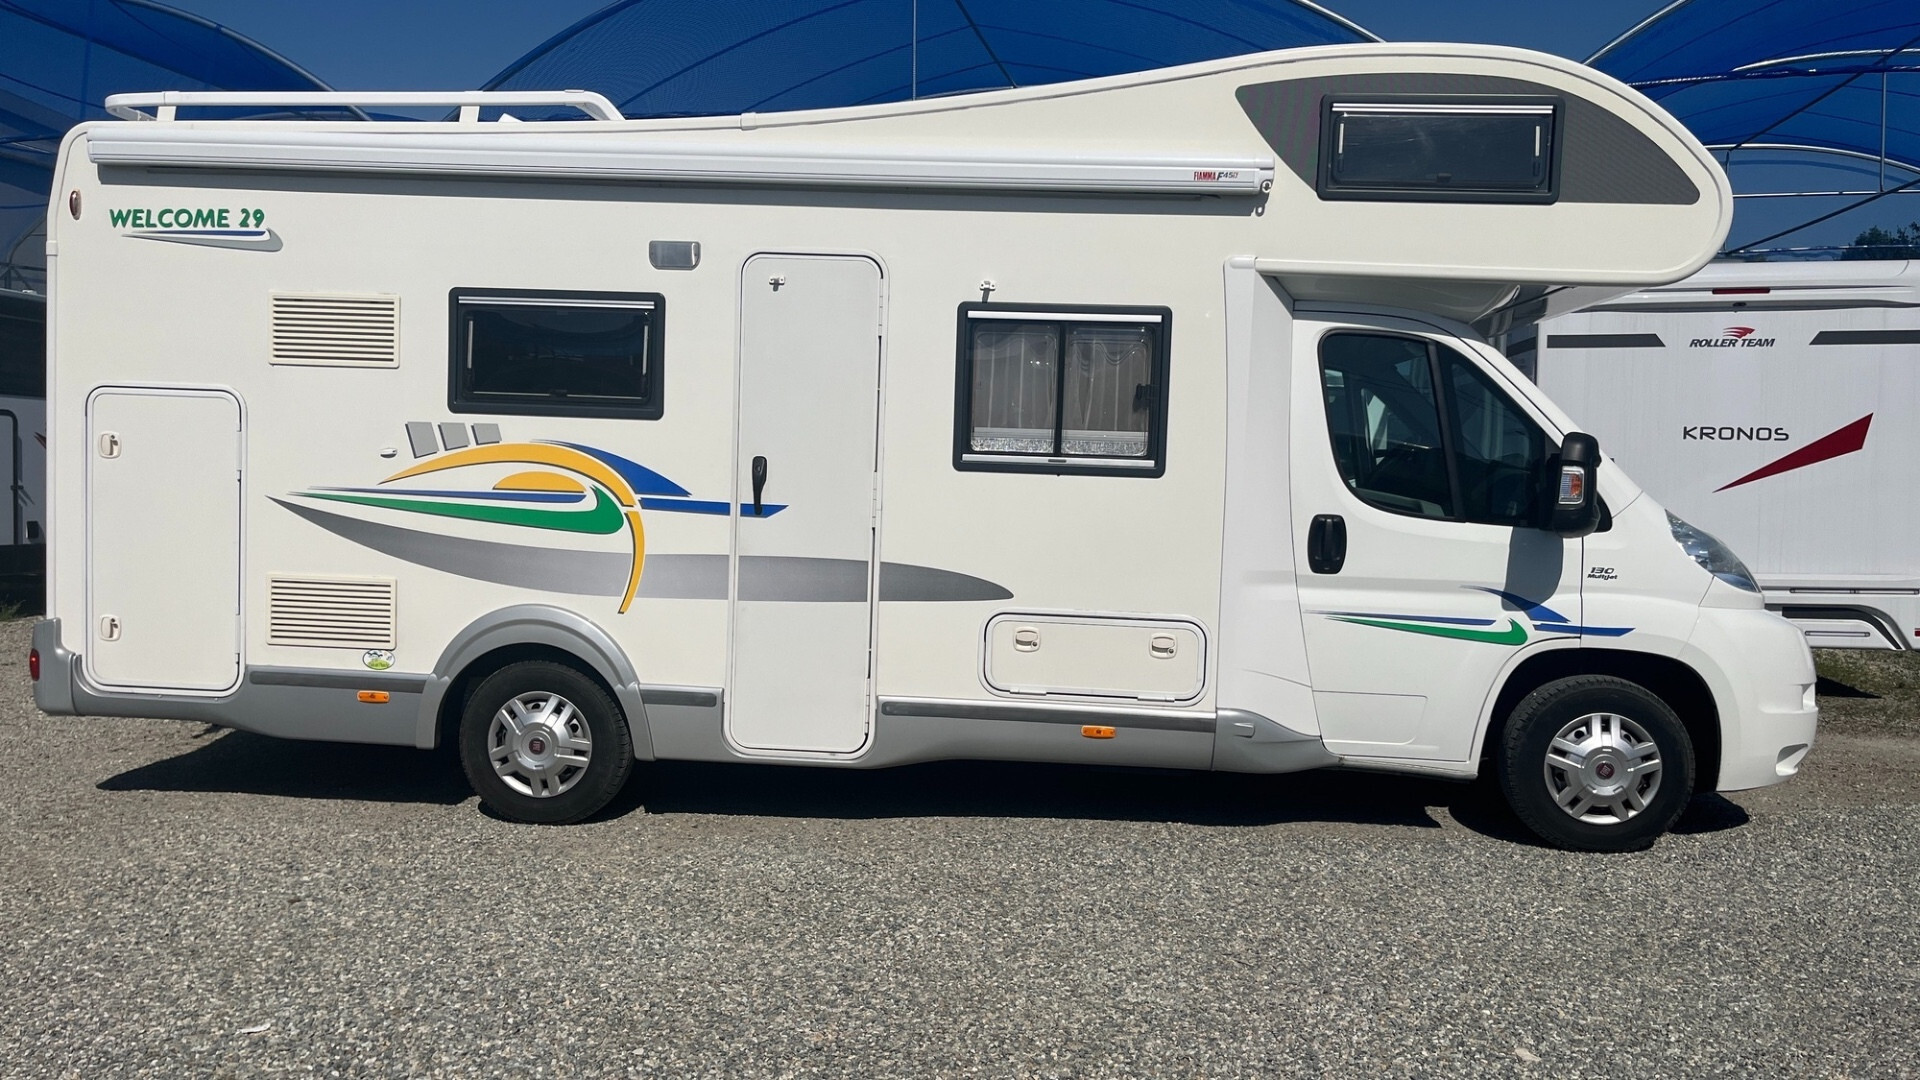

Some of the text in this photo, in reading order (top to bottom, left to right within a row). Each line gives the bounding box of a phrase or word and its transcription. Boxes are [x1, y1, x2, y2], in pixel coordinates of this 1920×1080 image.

[1193, 171, 1216, 181] FIAMMA
[109, 208, 265, 228] WELCOME 29
[1689, 338, 1775, 348] ROLLER TEAM
[1683, 426, 1789, 441] KRONOS
[1590, 566, 1615, 574] 130
